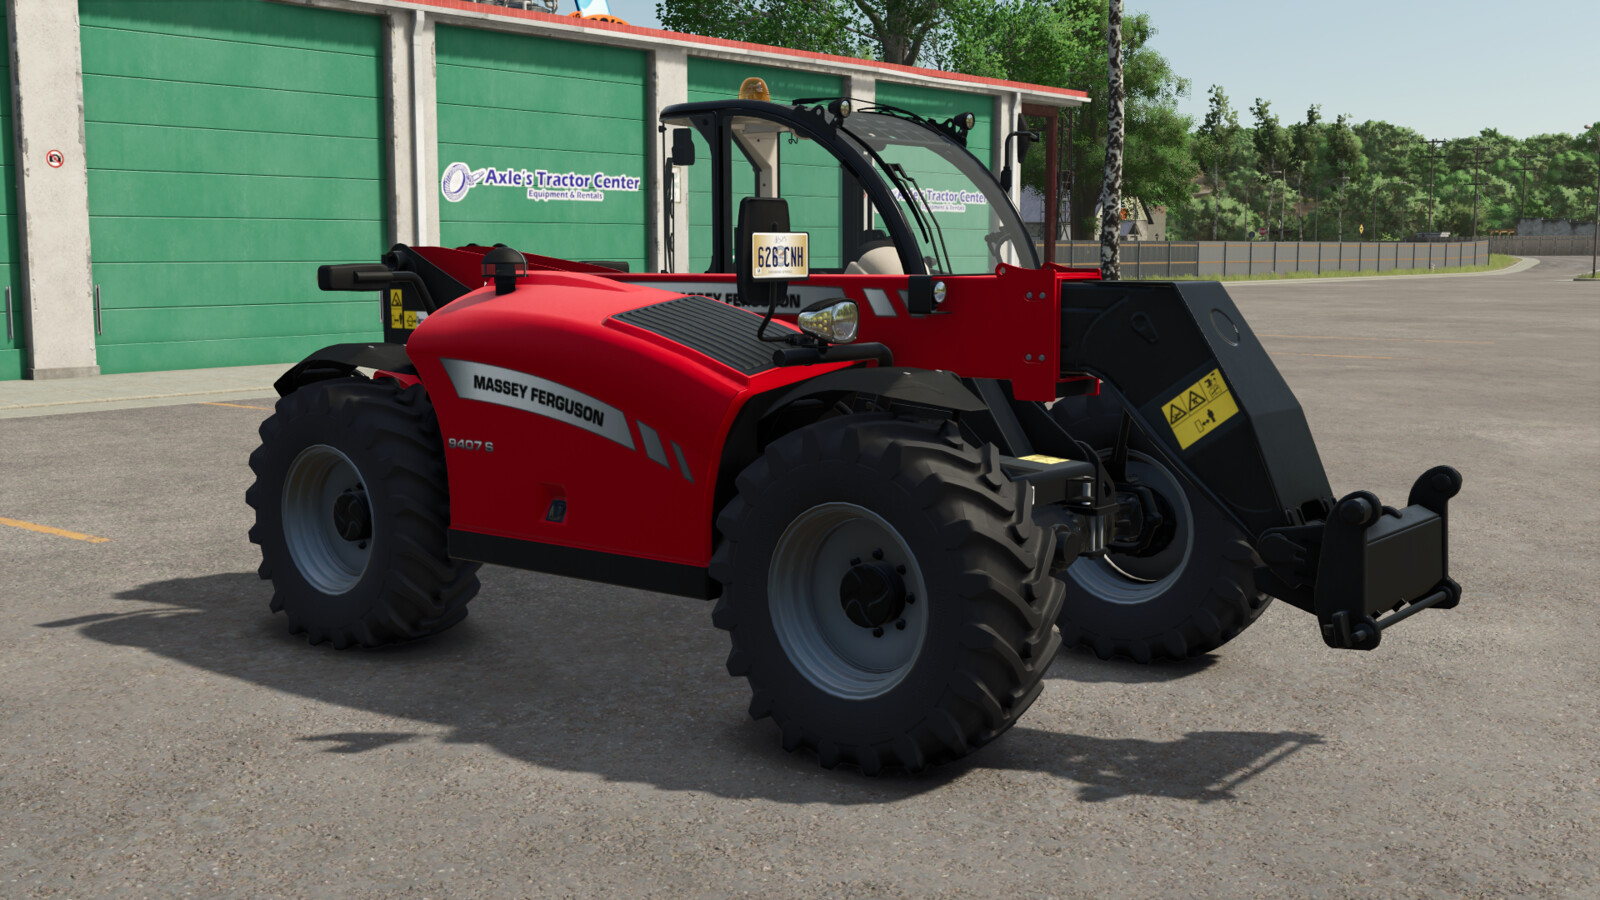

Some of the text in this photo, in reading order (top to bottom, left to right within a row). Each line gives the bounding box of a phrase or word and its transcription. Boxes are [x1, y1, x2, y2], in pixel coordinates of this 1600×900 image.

[485, 169, 640, 190] Axle's Tractor Center
[528, 189, 568, 199] Equipment
[577, 191, 603, 199] Rentals
[927, 190, 958, 202] Tractor
[758, 246, 803, 268] 626 CNH
[473, 374, 605, 427] MASSEY FERGUSON
[448, 437, 494, 452] 9407 S
